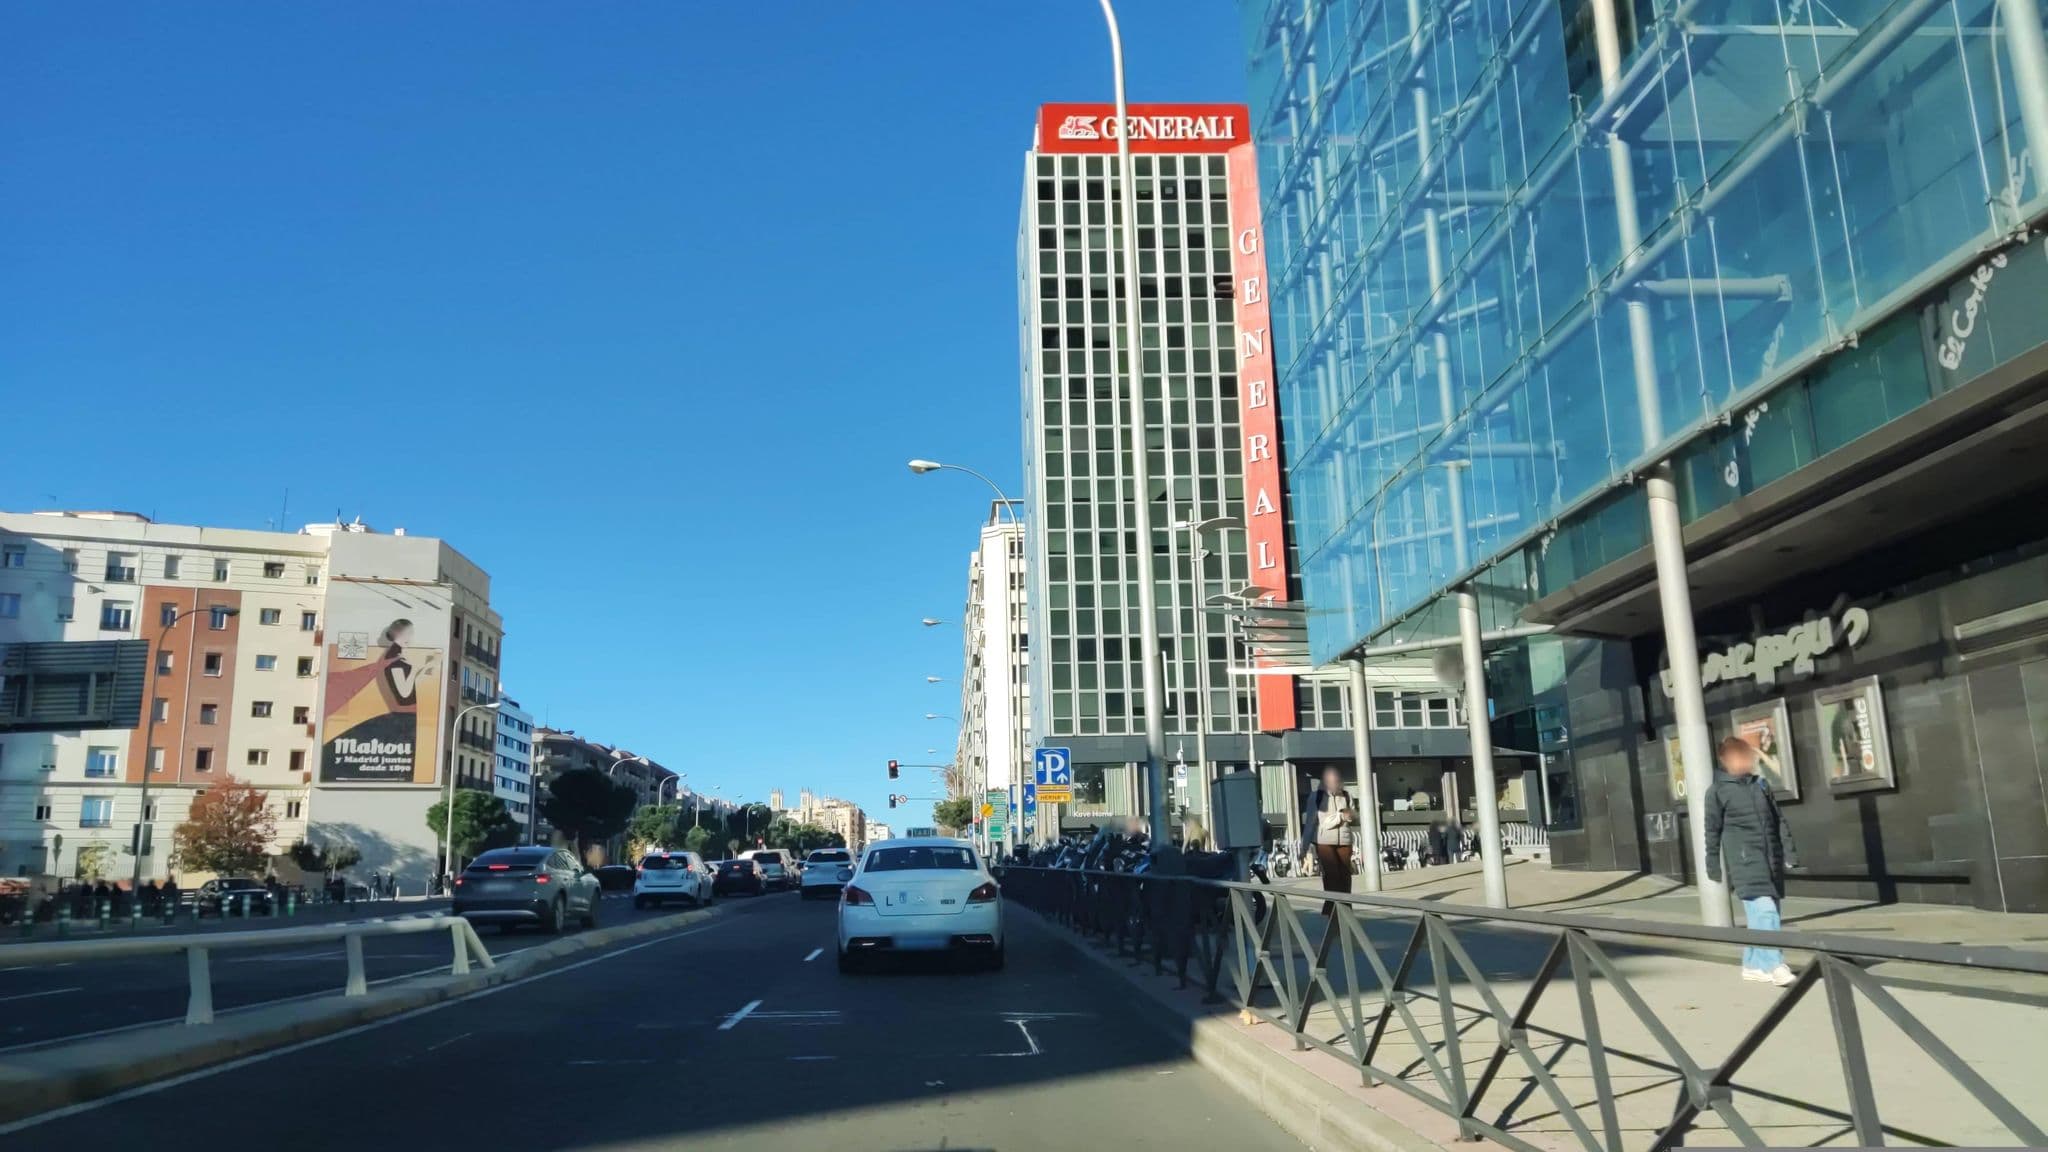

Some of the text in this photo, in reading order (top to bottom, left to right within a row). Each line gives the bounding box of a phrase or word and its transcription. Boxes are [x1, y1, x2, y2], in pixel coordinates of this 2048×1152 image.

[1101, 115, 1236, 141] GENERALI
[334, 738, 412, 754] Mahou
[334, 755, 412, 765] y Madrid juntas
[359, 764, 412, 773] desde 1890
[886, 896, 893, 906] L
